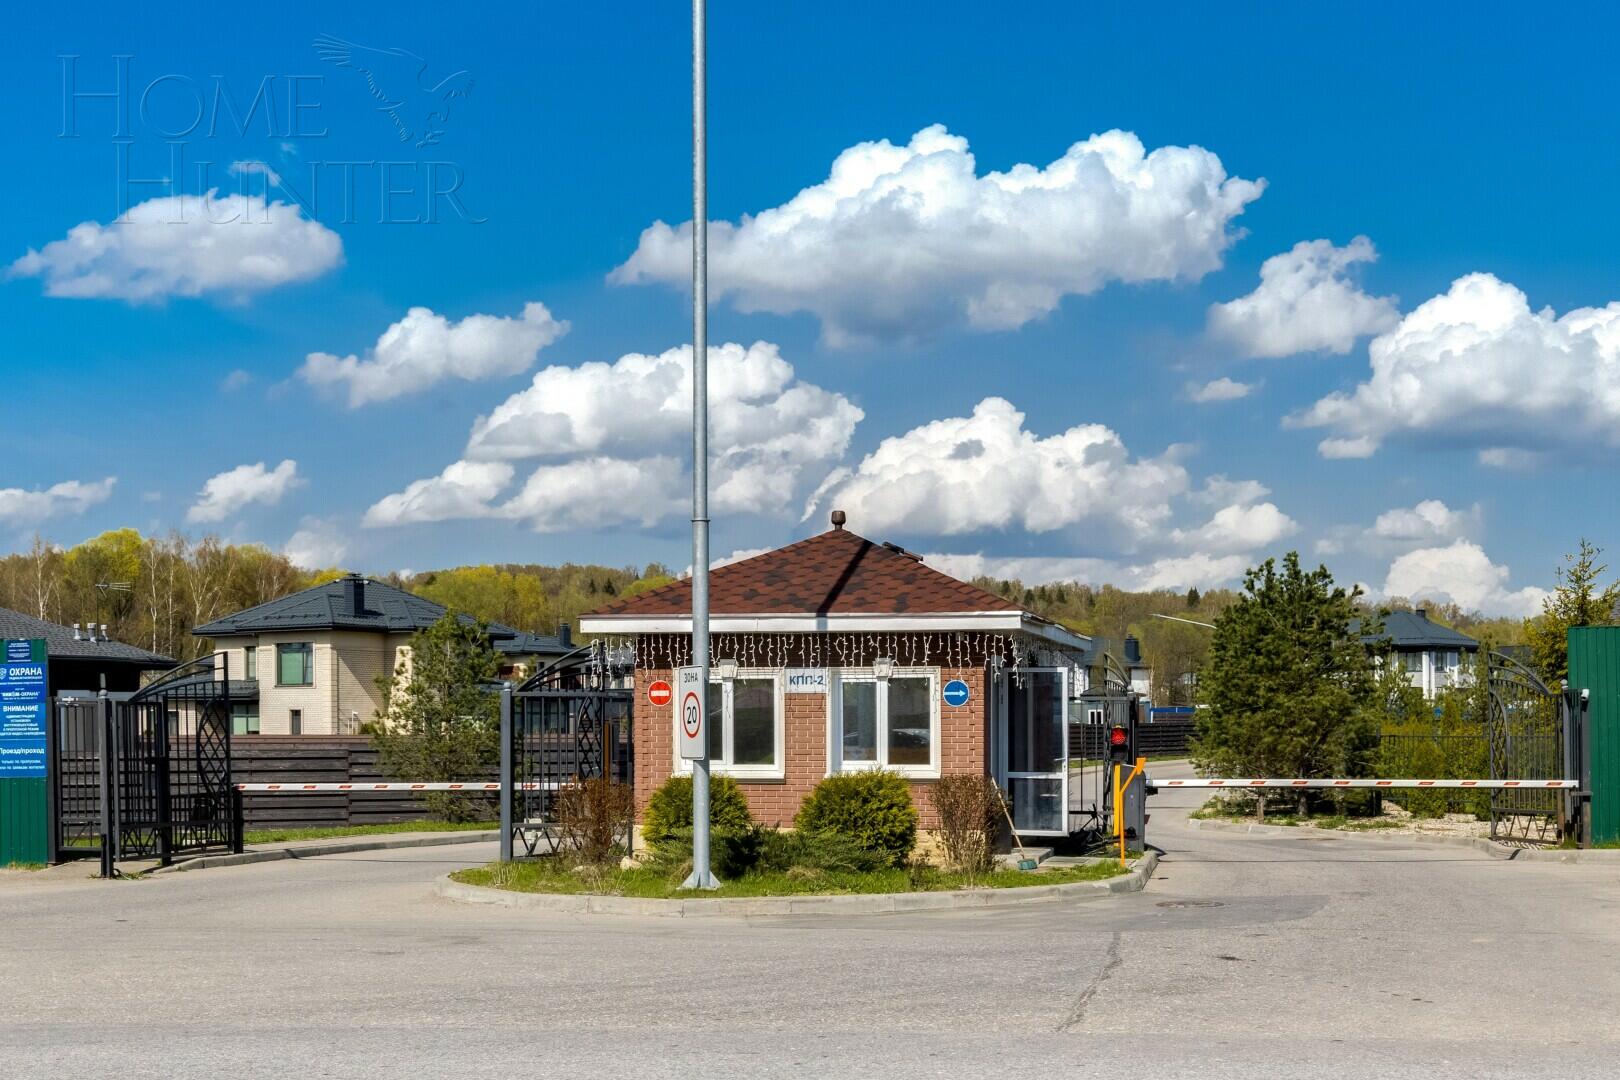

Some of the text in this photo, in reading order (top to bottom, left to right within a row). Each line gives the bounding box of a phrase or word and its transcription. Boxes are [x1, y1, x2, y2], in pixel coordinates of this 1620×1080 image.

[9, 667, 42, 676] ОХРАНА
[683, 672, 699, 683] ЗОНА
[789, 674, 824, 686] КПП-2
[2, 704, 39, 712] ВНИМАНИЕ
[686, 706, 697, 724] 20
